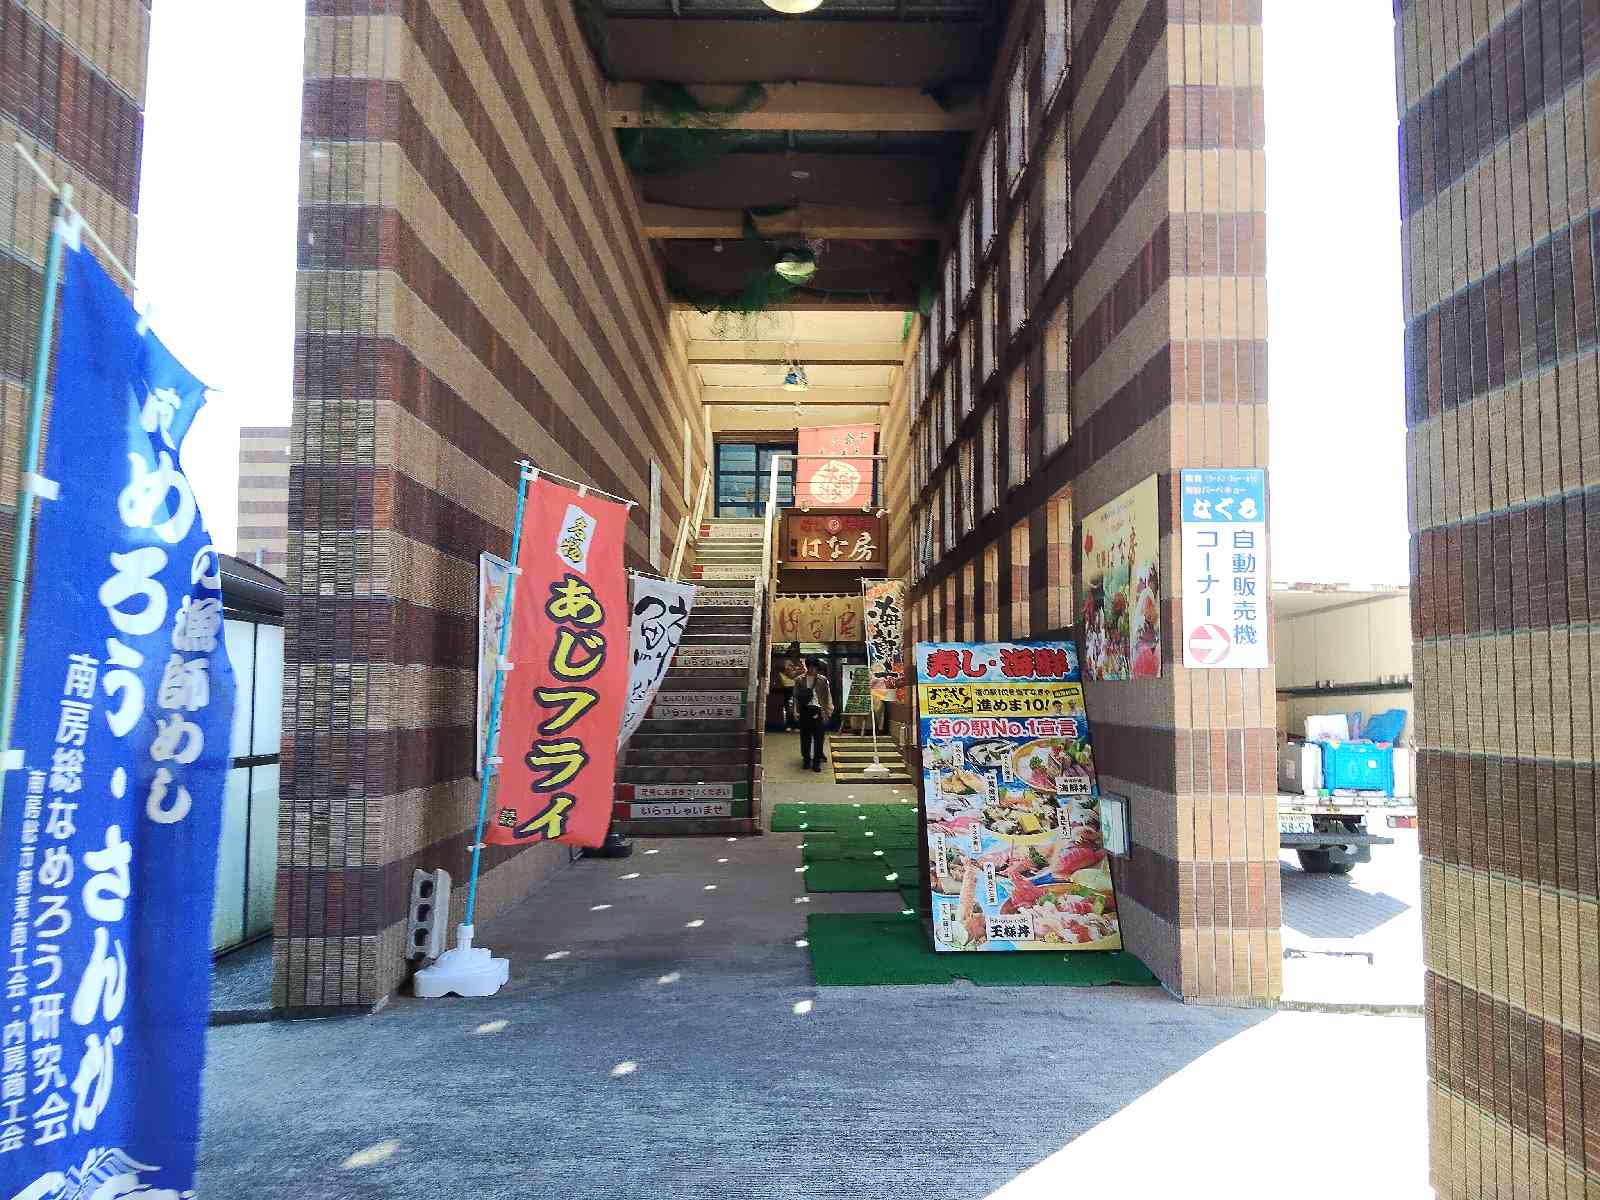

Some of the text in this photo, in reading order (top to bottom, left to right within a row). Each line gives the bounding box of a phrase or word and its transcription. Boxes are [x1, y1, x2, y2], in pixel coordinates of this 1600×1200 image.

[1197, 531, 1219, 617] コーナー
[1232, 530, 1257, 645] 自動販売機
[926, 648, 1071, 678] 寿し・海鮮
[513, 573, 606, 839] あじフライ
[931, 719, 1078, 738] 道の駅No.1宣言
[976, 699, 1050, 713] 進めま10!
[640, 805, 723, 816] いらっしゃいませ
[32, 654, 99, 1146] 南房総なめろう研究会
